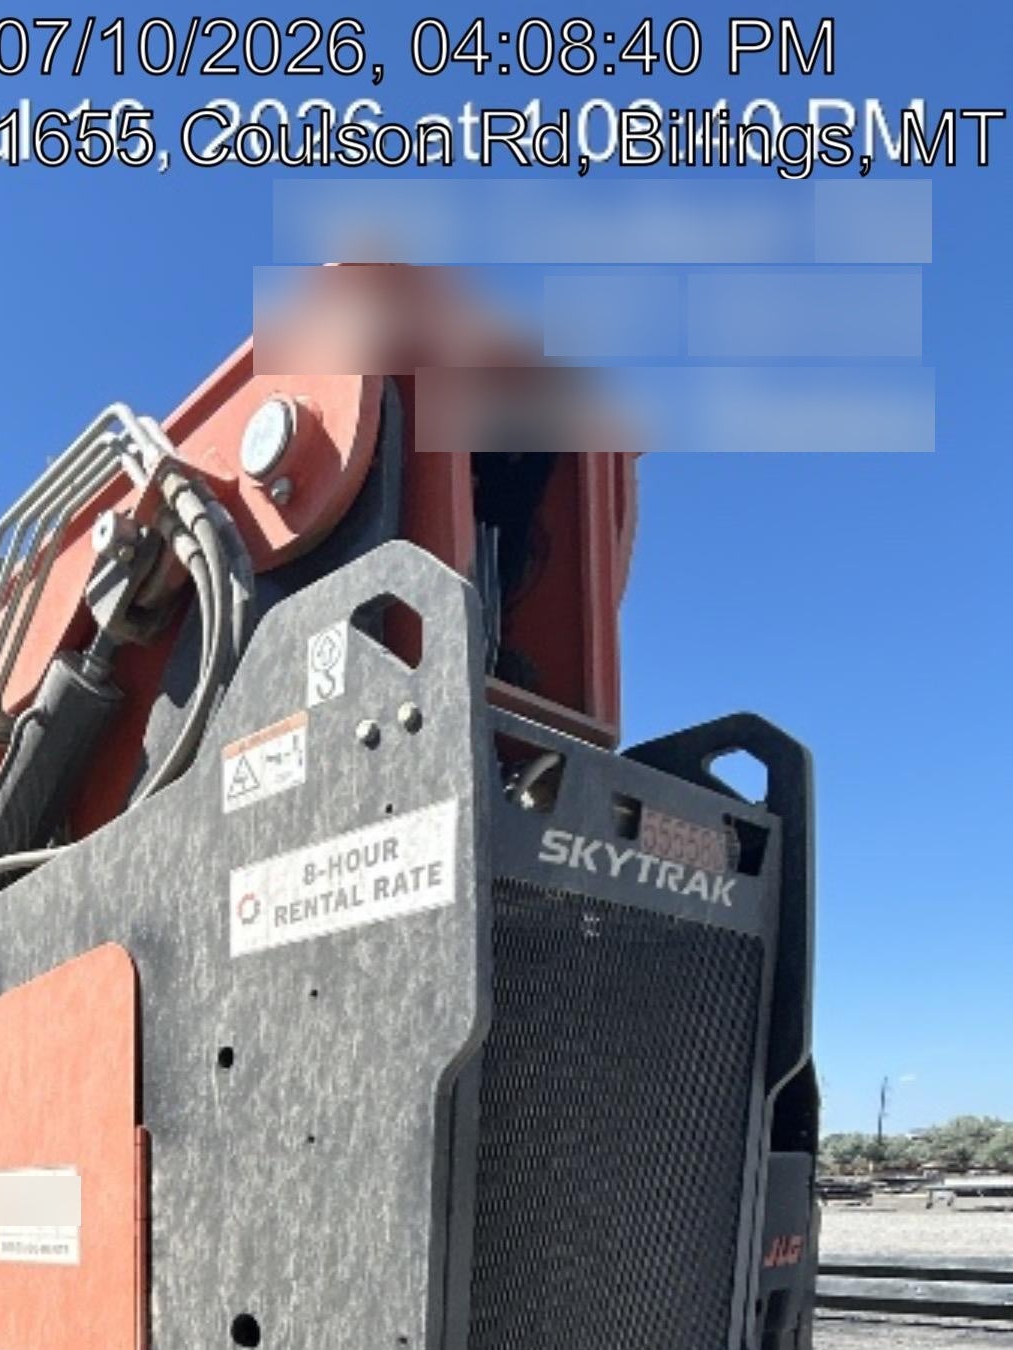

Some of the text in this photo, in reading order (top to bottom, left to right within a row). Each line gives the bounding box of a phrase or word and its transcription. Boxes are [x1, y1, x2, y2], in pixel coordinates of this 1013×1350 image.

[302, 837, 399, 886] 8-HOUR
[538, 829, 736, 907] SKYTRAK
[274, 861, 442, 927] RENTAL RATE
[763, 1235, 803, 1267] JLG
